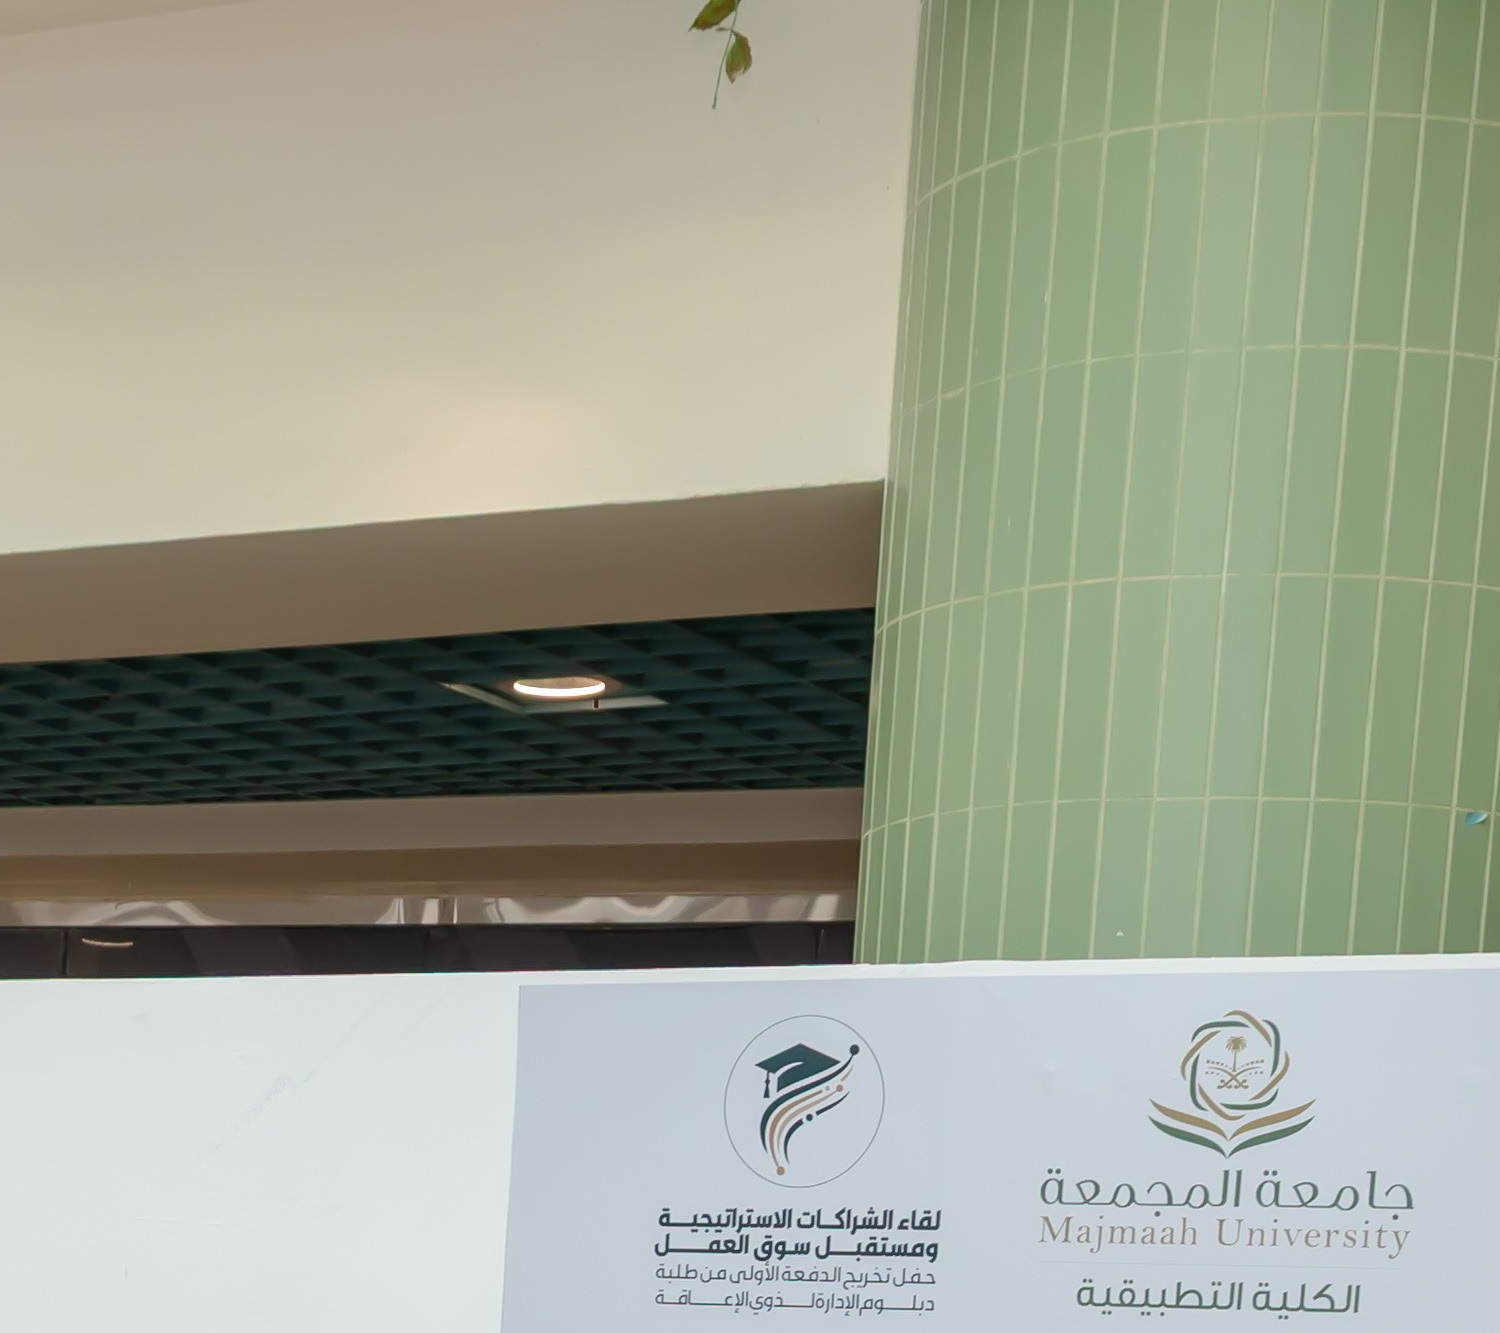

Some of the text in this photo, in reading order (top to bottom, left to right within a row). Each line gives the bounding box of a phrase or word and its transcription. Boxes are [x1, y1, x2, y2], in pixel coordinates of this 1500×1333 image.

[1039, 1167, 1415, 1223] جامعة المجمعة
[657, 1206, 942, 1237] لقاء الشراكات الاستراتيجية
[1038, 1213, 1411, 1260] Majmaah University
[653, 1231, 940, 1264] ومستقبل سوق العمل
[655, 1260, 937, 1291] حفل تخريج الدفعة الأولى من طلبة
[654, 1288, 750, 1314] الإعاقة
[1075, 1277, 1362, 1321] الكلية التطبيقية
